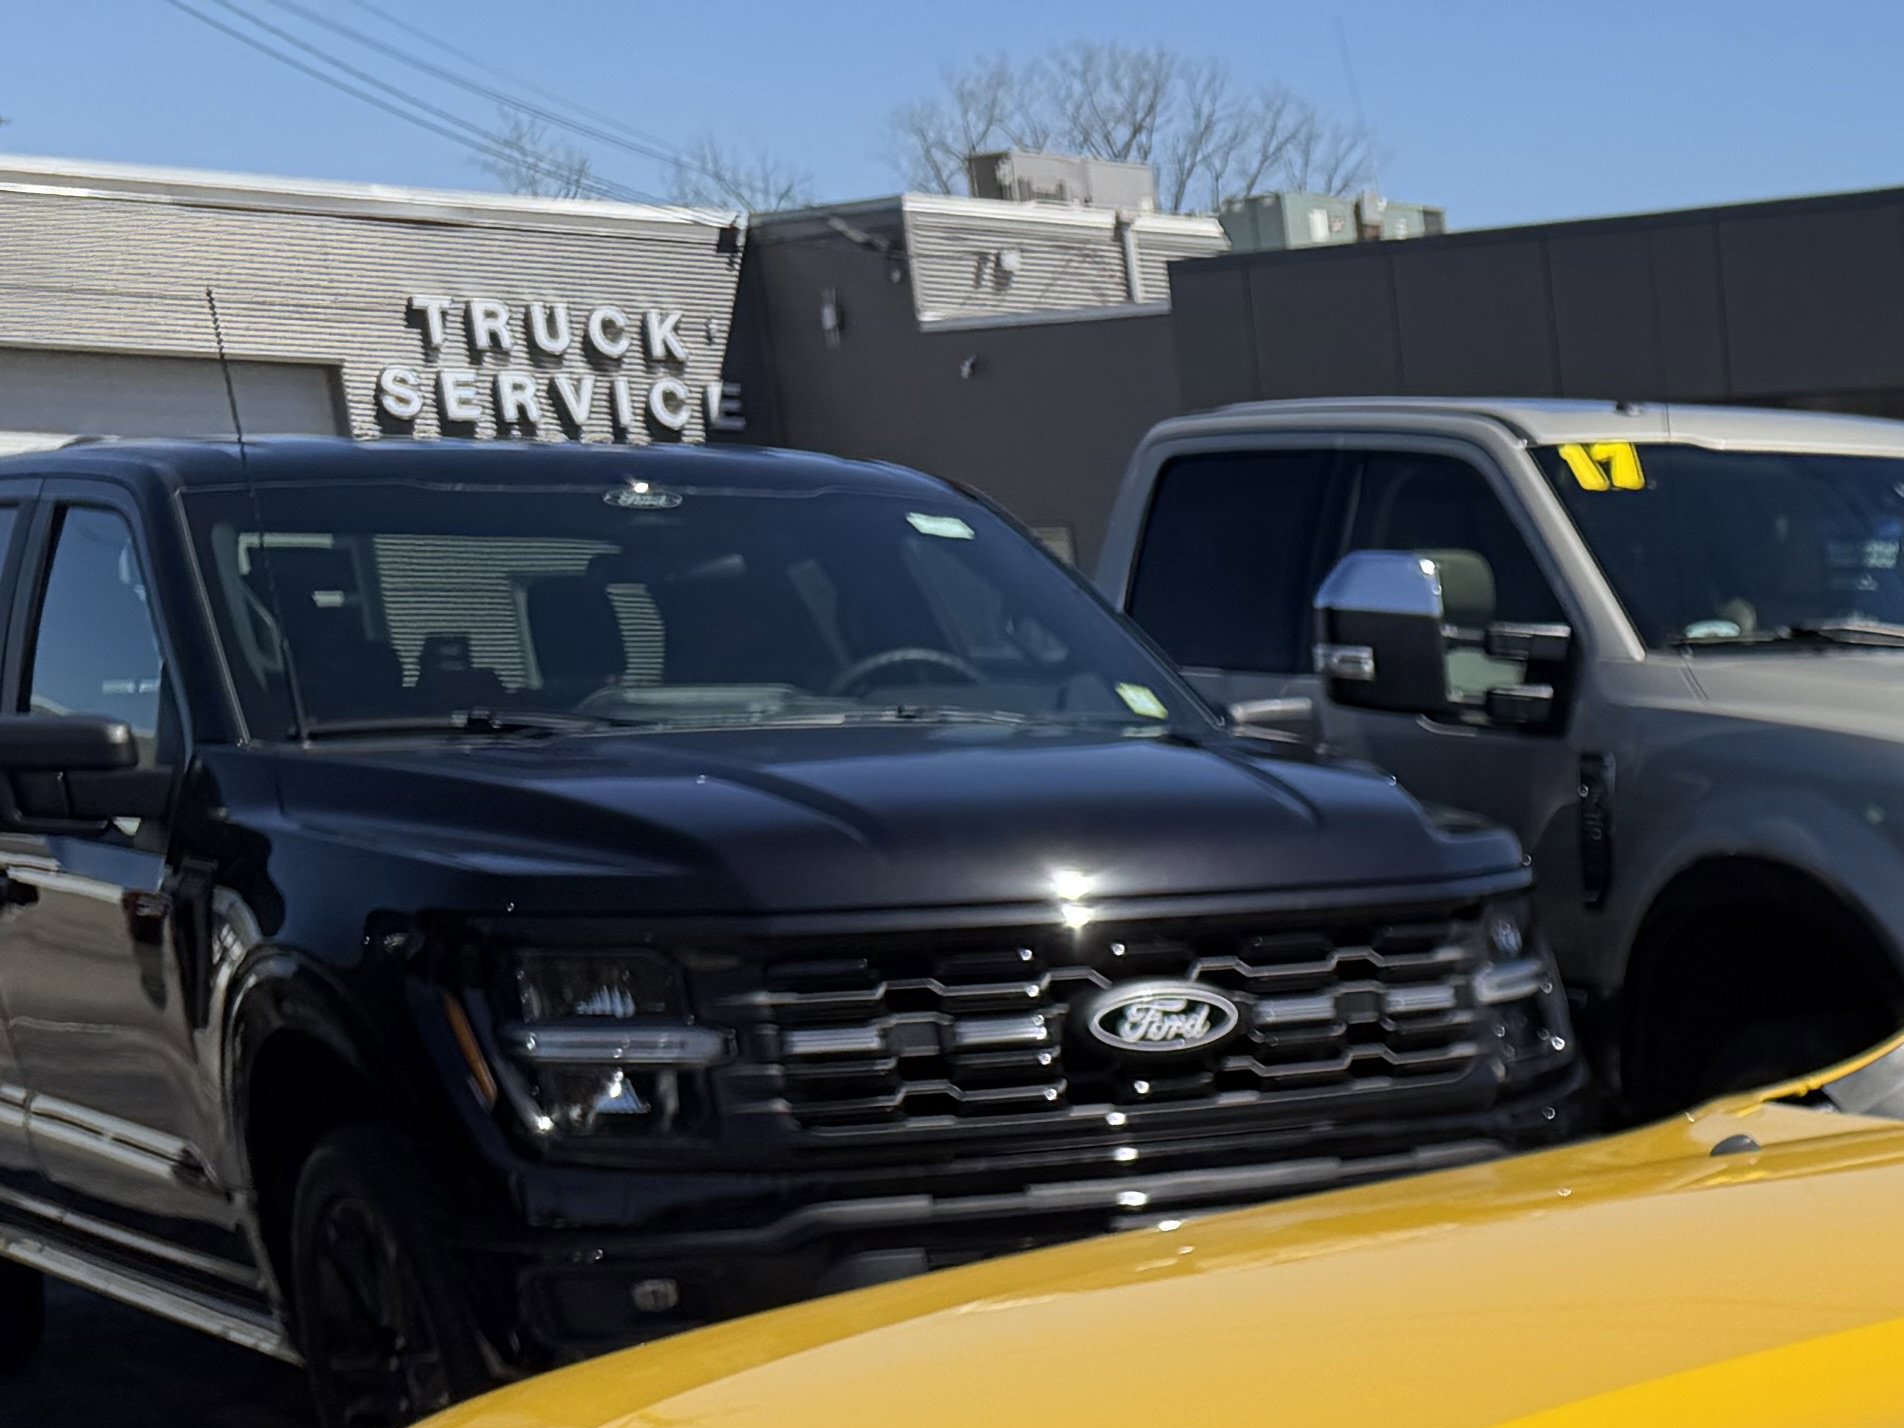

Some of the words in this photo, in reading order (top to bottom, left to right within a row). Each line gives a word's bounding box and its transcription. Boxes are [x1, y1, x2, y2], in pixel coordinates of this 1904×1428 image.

[411, 295, 690, 362] TRUCK
[379, 364, 747, 432] SERVICE
[1557, 441, 1646, 492] 17
[1120, 999, 1212, 1043] Ford
